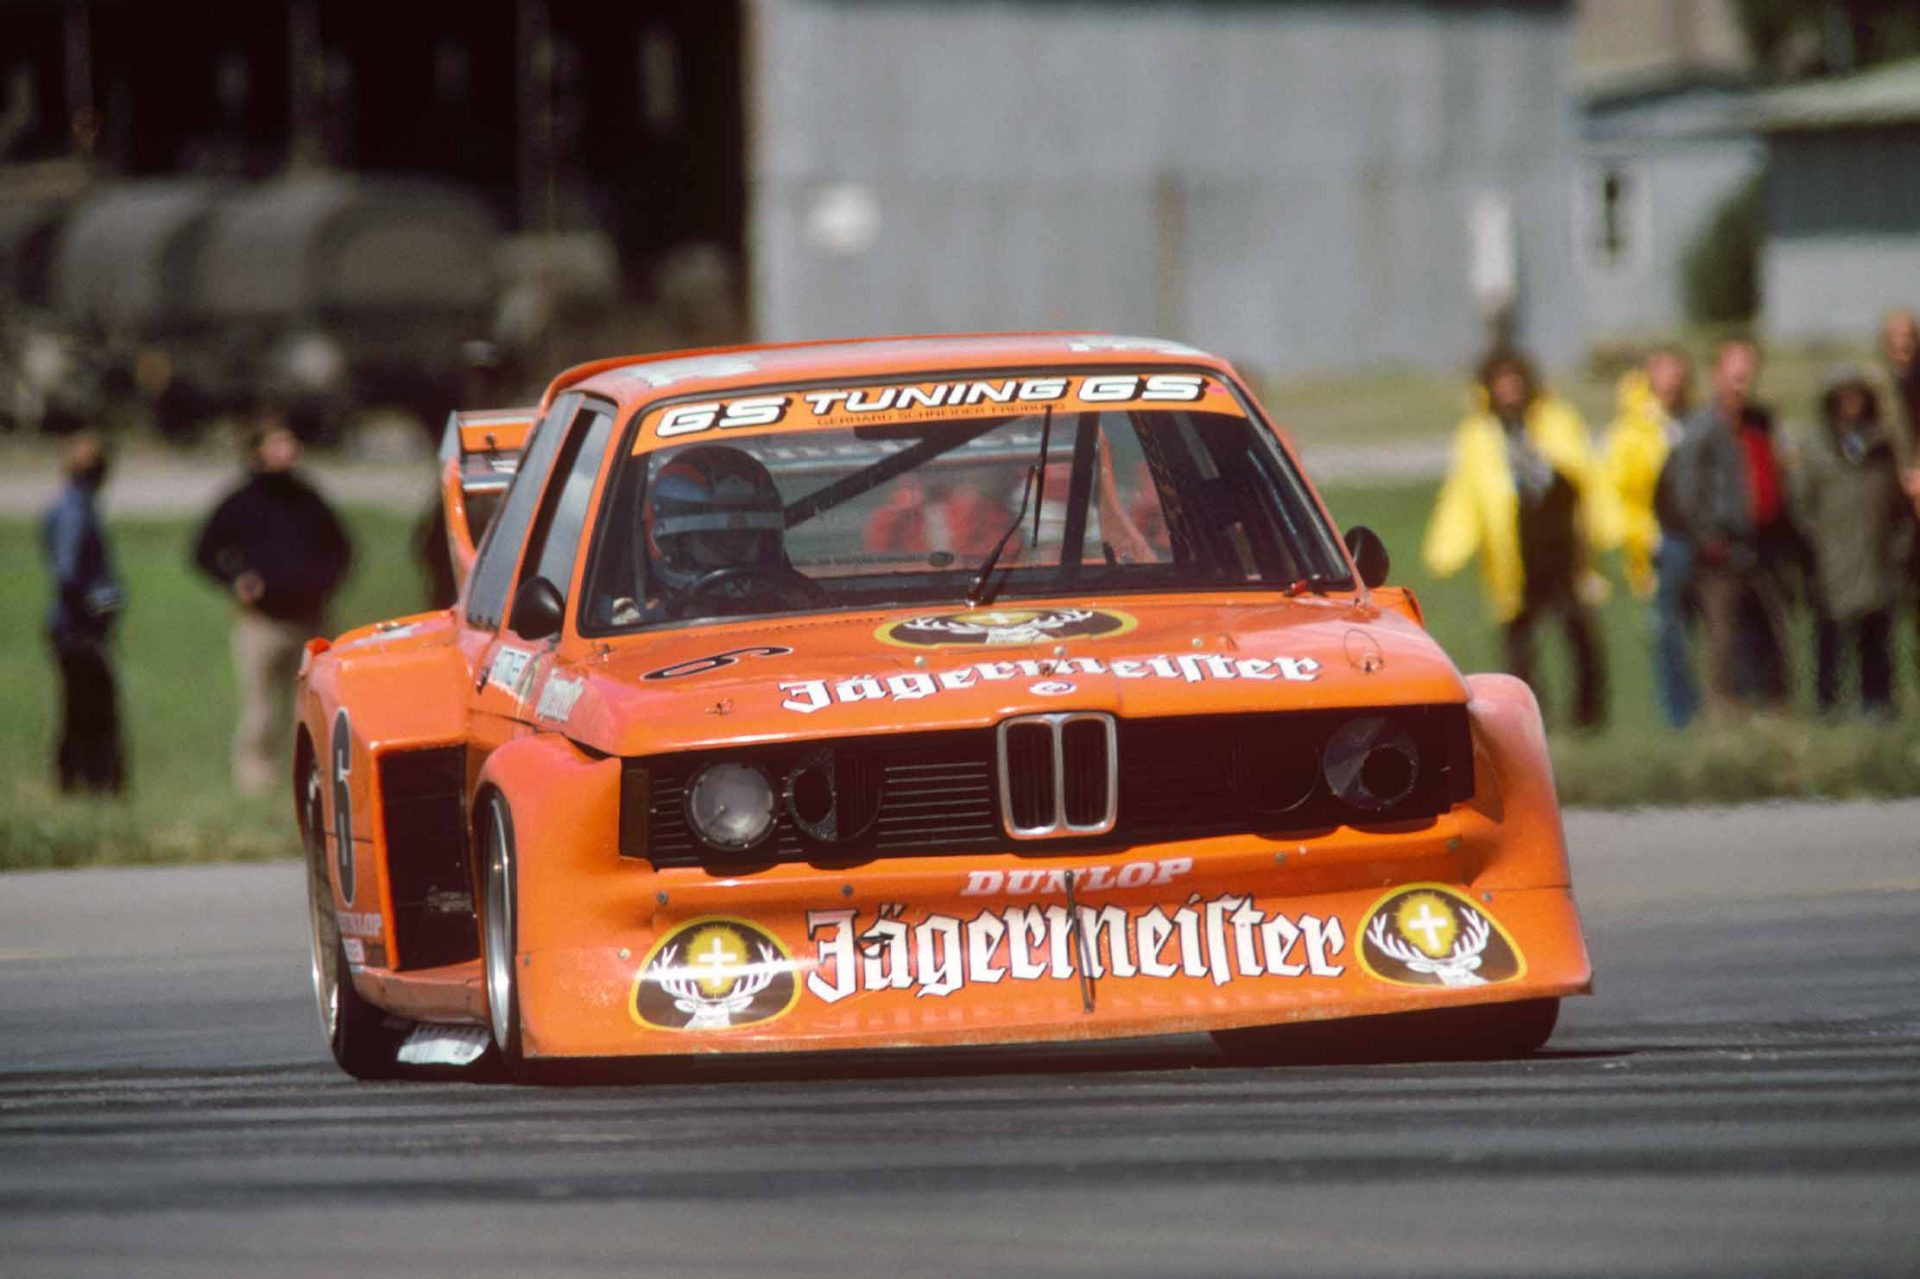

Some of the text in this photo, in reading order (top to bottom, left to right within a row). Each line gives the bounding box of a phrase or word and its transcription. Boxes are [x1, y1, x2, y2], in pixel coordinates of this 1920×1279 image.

[656, 374, 1209, 437] GS TUNING GS
[960, 857, 1194, 896] DUNLOP
